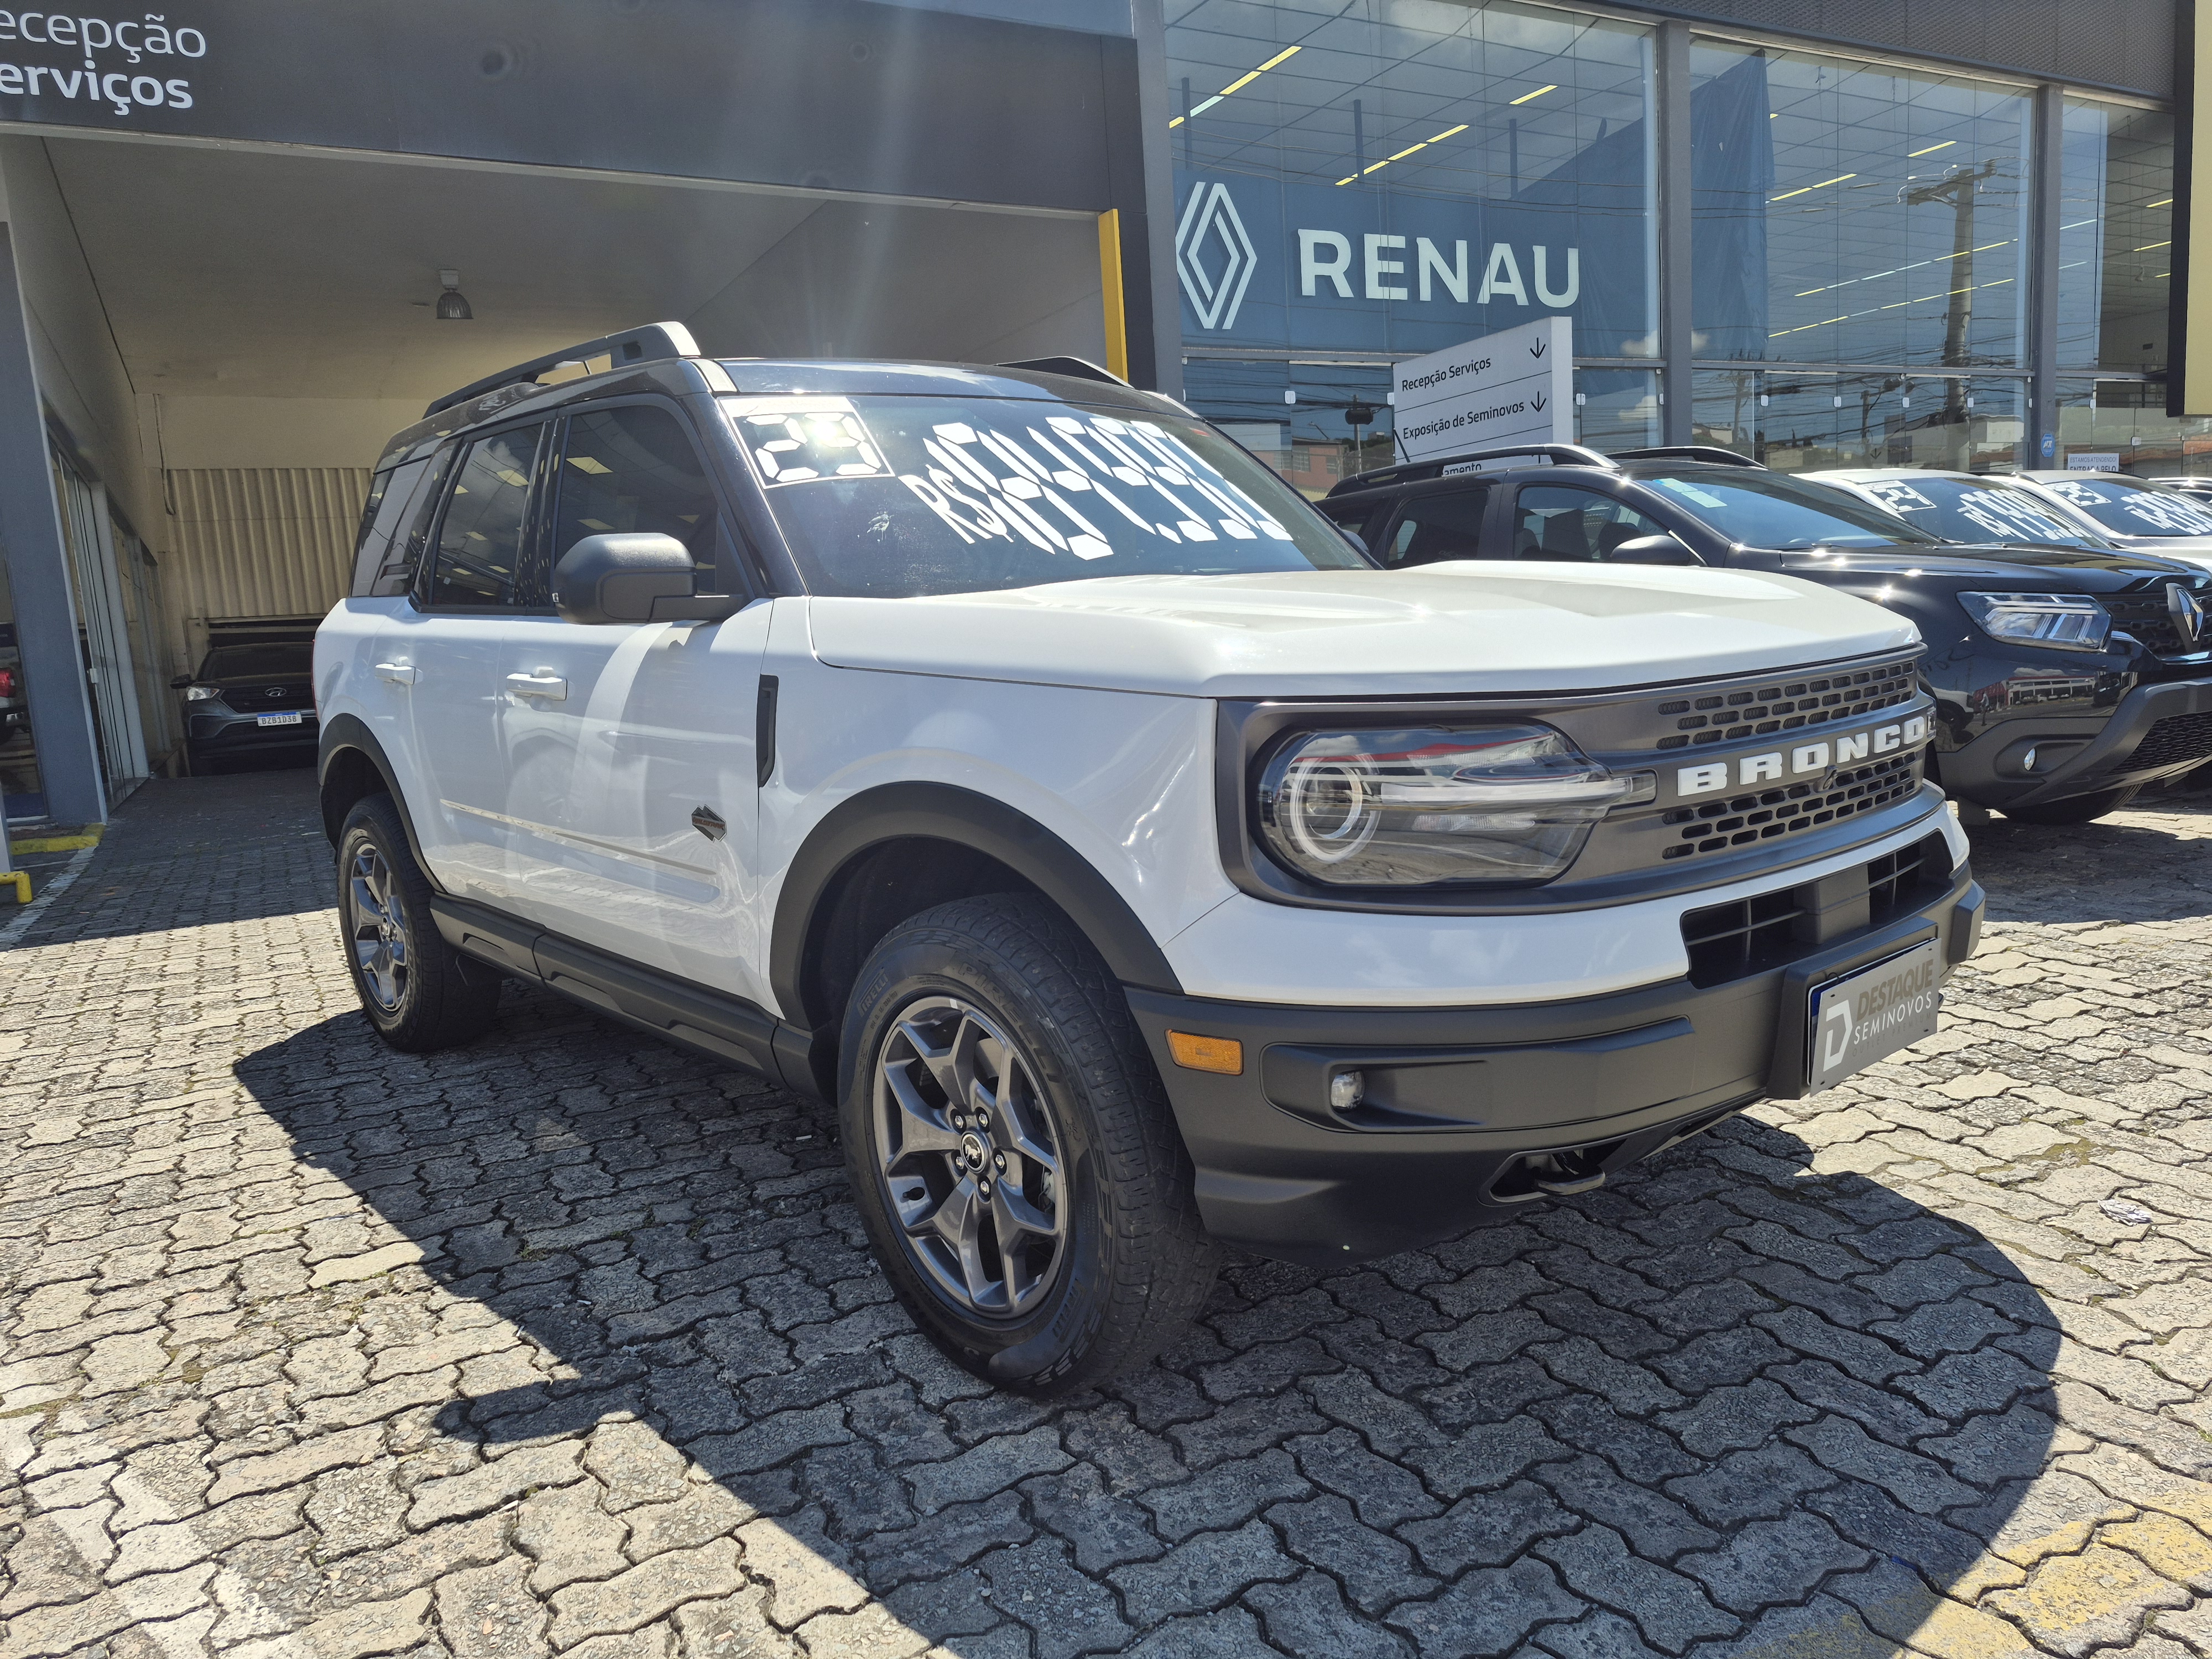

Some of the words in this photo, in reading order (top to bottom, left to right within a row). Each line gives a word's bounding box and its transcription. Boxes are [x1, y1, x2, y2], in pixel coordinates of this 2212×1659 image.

[1297, 228, 1580, 308] RENAU
[1401, 369, 1447, 392] Recepção
[1448, 358, 1491, 378] Serviços
[746, 412, 882, 483] 23
[1403, 419, 1450, 440] Exposição
[1452, 414, 1465, 427] de
[1467, 401, 1525, 424] Seminovos
[261, 716, 297, 725] BZB1D38
[1677, 716, 1925, 797] BRONCO
[1856, 958, 1934, 1022] DESTAQUE
[1853, 1033, 1886, 1057] OUTLET
[1891, 1011, 1932, 1037] PREMIUM
[1854, 991, 1932, 1045] SEMINOVOS
